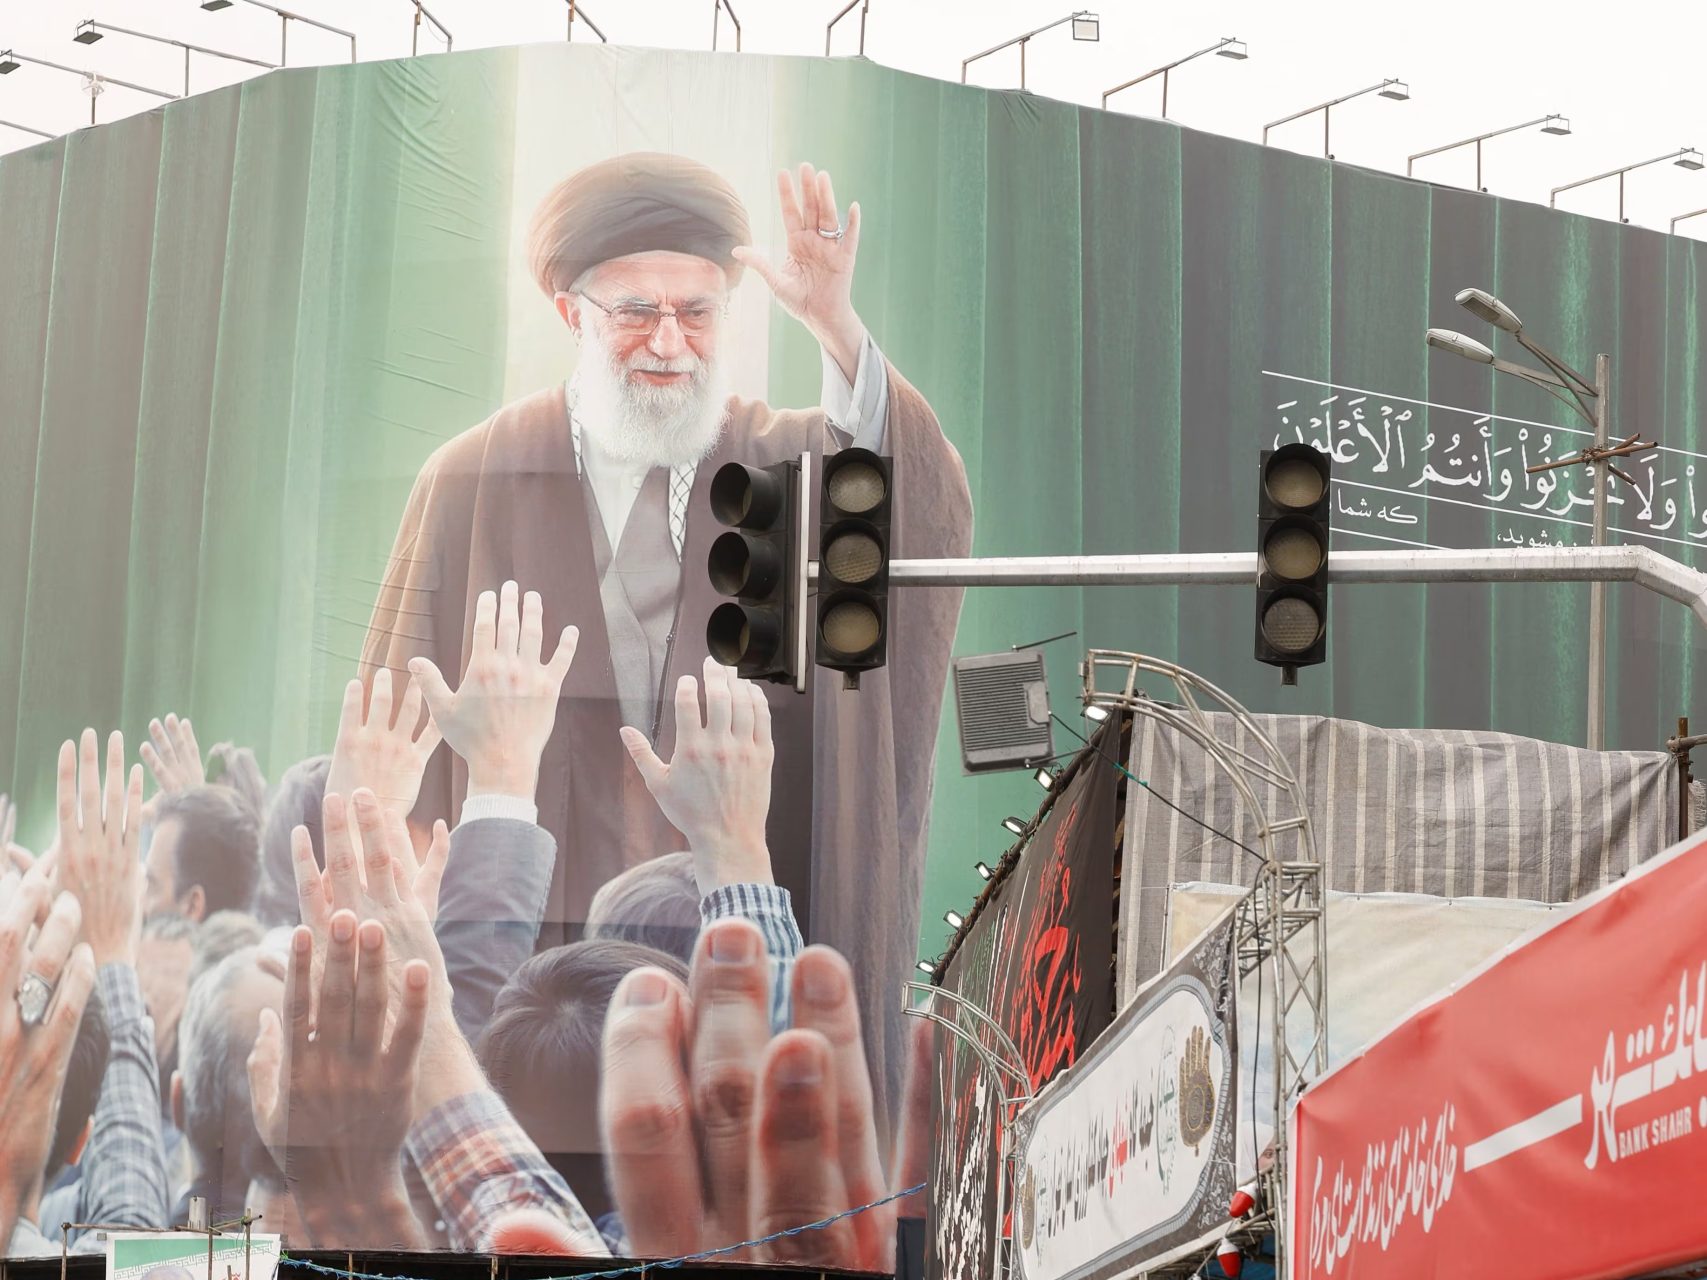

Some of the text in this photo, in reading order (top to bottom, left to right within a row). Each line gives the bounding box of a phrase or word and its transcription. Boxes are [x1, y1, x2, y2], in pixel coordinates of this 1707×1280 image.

[1337, 488, 1372, 518] شما
[1377, 505, 1418, 524] که
[1618, 1106, 1693, 1159] BANK SHAHR
